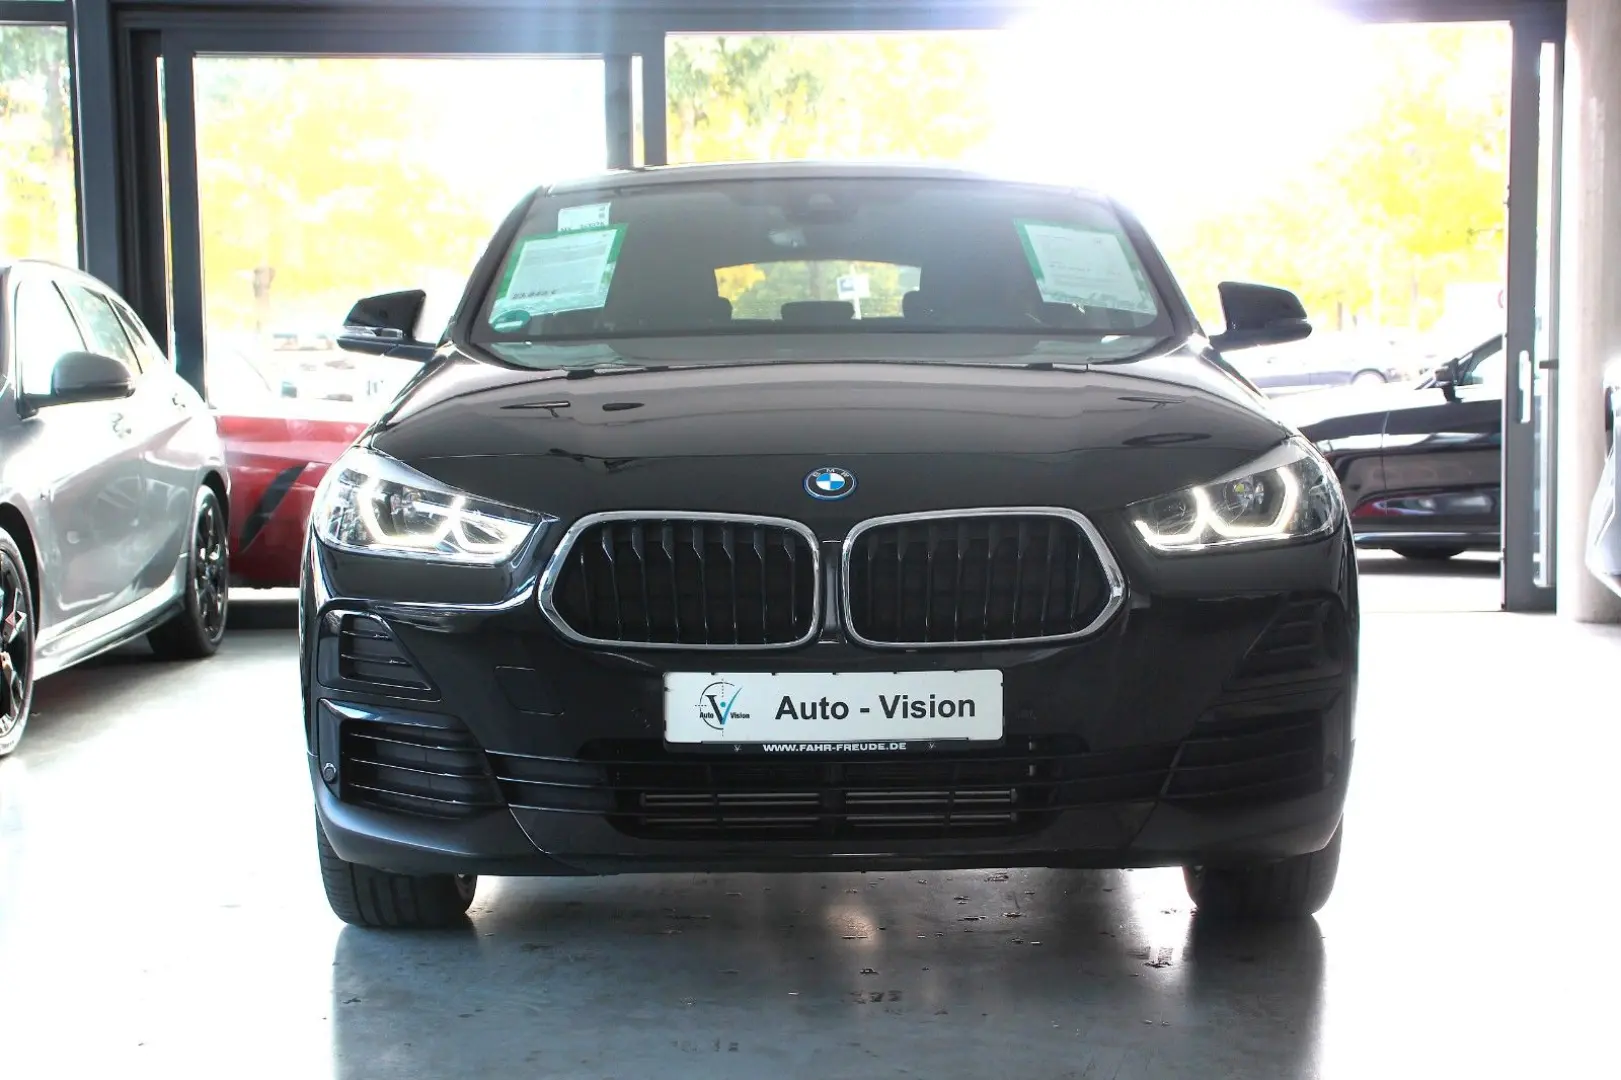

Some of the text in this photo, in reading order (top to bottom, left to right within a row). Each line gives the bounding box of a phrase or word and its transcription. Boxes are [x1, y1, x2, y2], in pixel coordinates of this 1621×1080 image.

[775, 695, 849, 720] Auto
[878, 694, 976, 719] Vision
[730, 711, 750, 719] Vision
[763, 742, 907, 752] WWW.FAHR-FREUDE.DE
